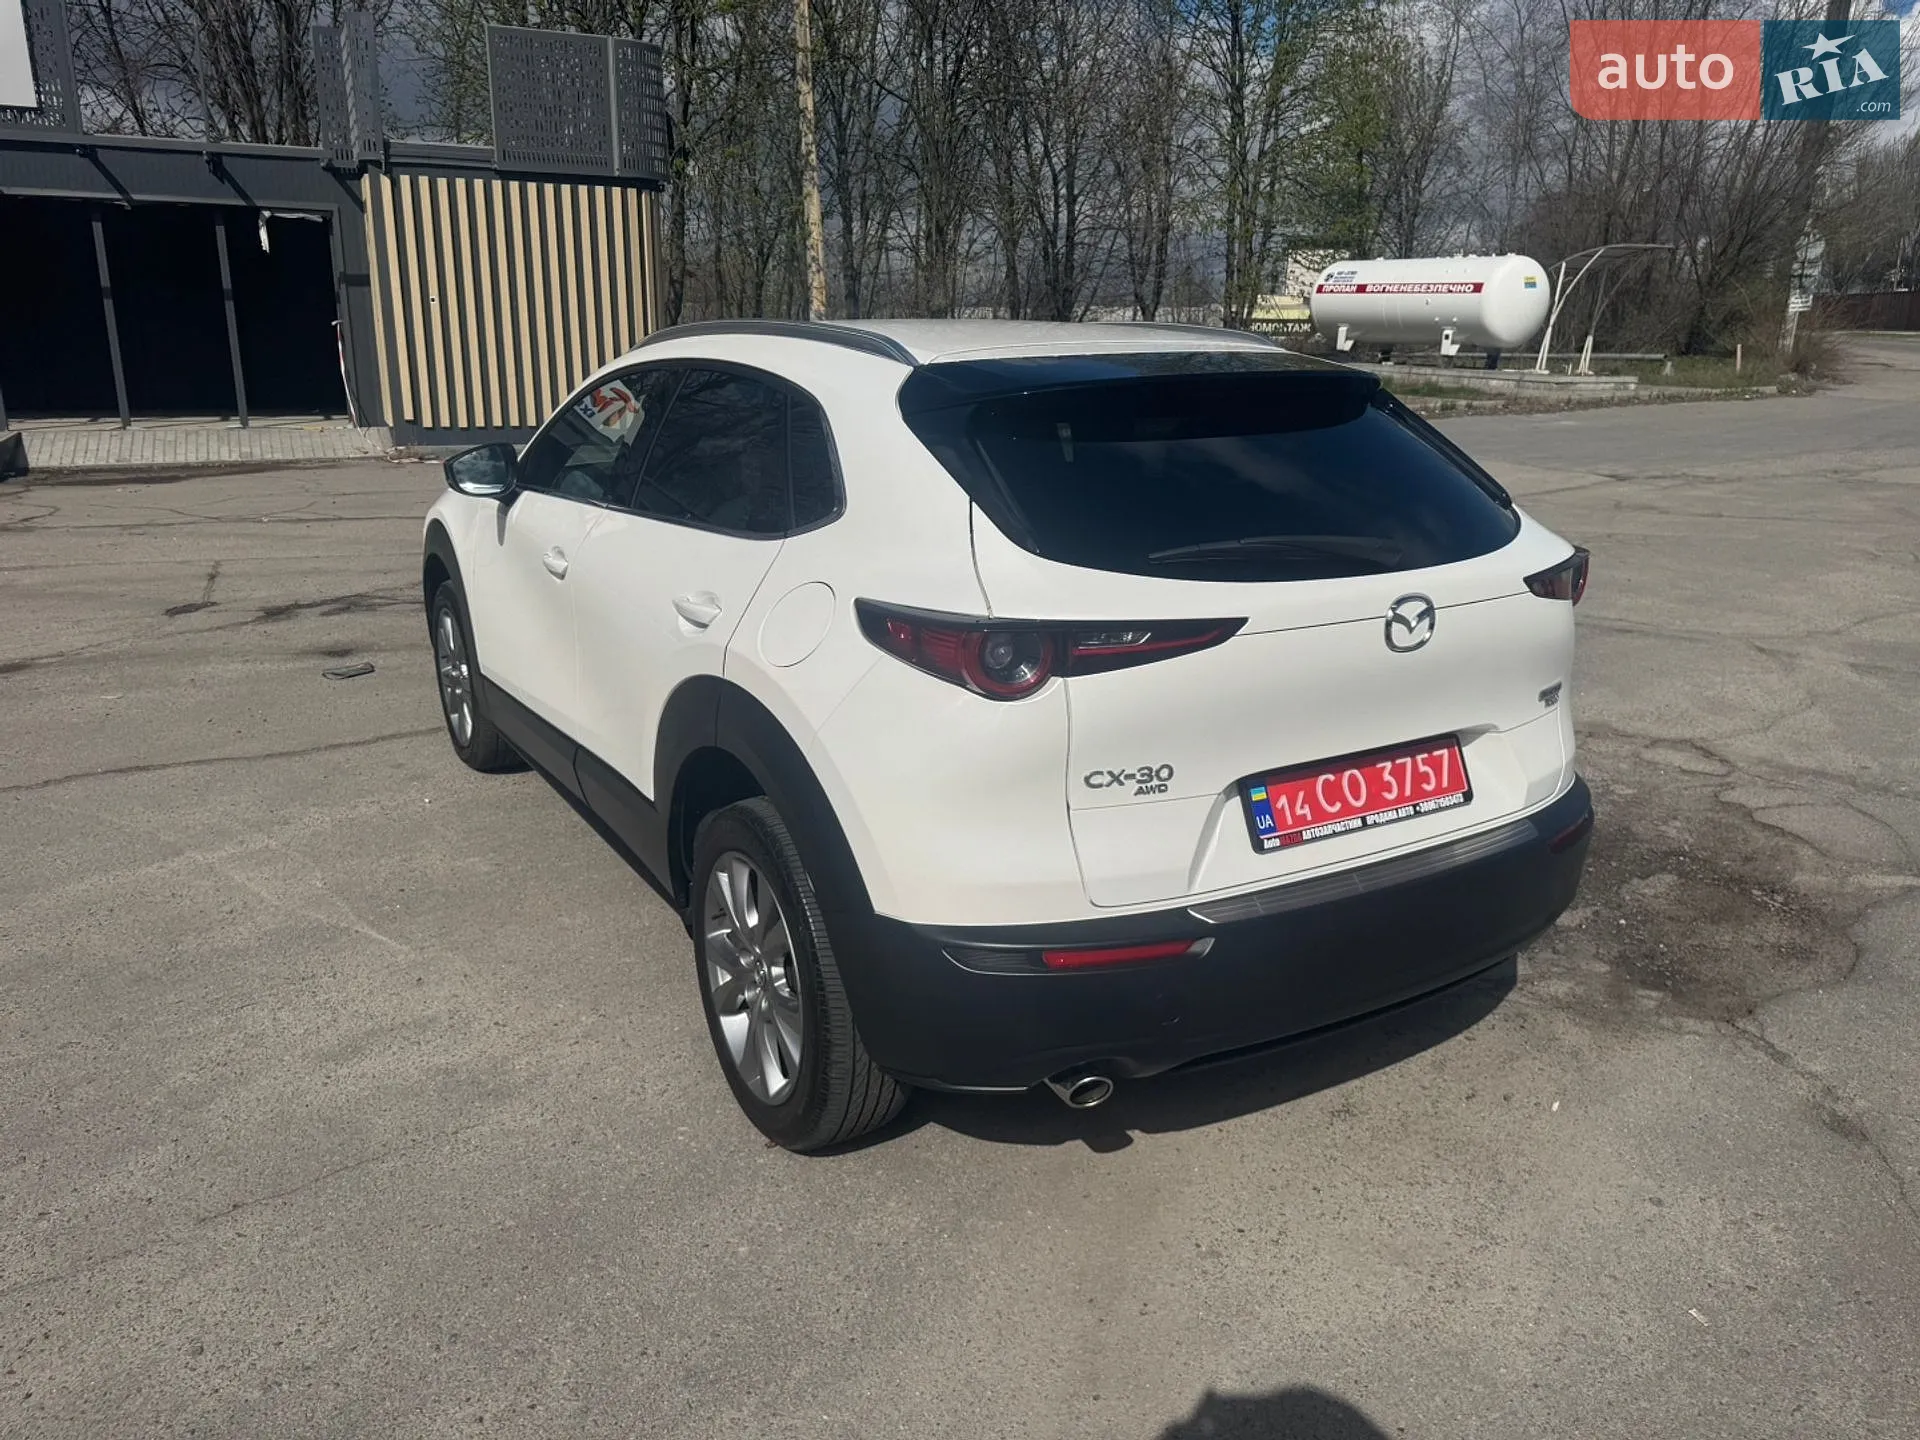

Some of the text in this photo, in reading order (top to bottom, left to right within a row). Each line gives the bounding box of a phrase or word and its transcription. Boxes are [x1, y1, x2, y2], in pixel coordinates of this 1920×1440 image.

[1321, 282, 1475, 293] ПРОПАН ВОГНЕНЕБЕЗПЕЧНО
[1083, 763, 1175, 789] CX-30
[1133, 783, 1168, 796] AWD
[1276, 748, 1451, 826] 14 CO 3757
[1255, 815, 1274, 830] UA
